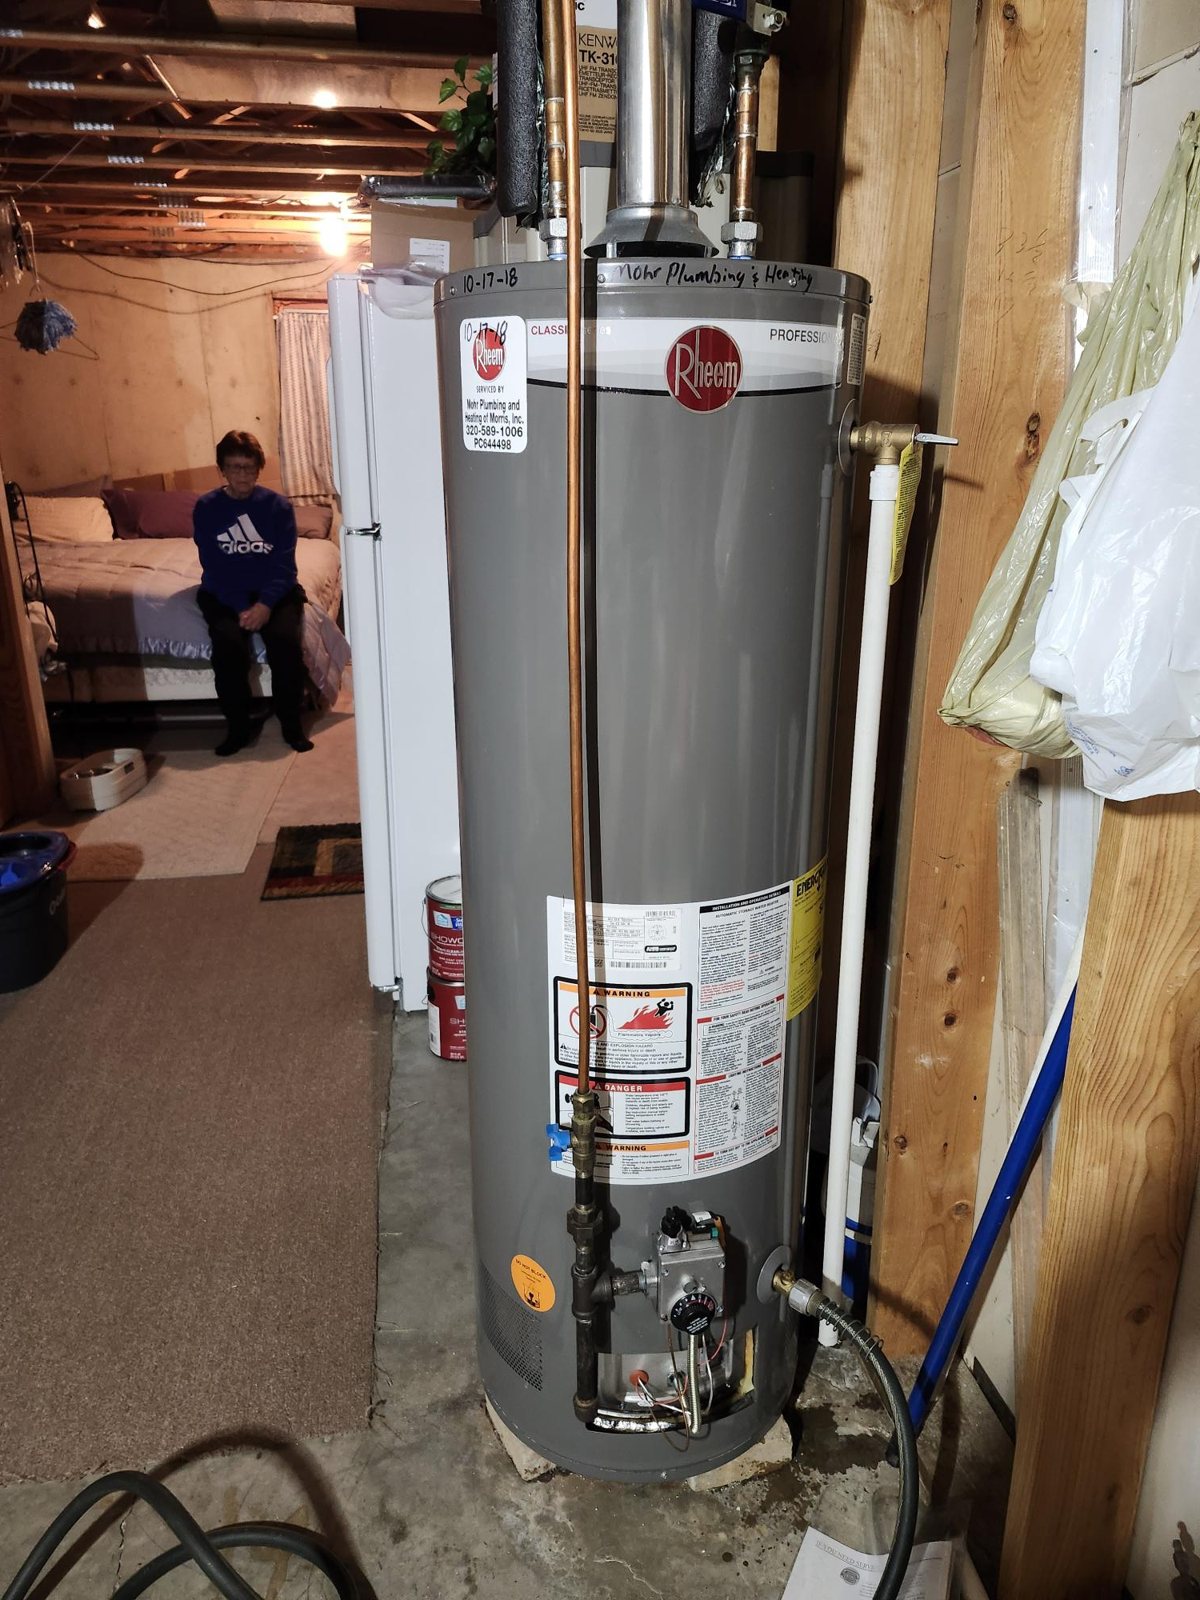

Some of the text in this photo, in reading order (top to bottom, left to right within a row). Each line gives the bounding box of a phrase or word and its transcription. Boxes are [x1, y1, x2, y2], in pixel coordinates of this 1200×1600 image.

[578, 33, 617, 48] KENW
[578, 49, 617, 65] TK-31
[463, 267, 519, 293] 10-17-18
[666, 262, 746, 288] Plumbing
[464, 320, 508, 346] 10-17-18
[530, 324, 568, 336] CLASSI
[475, 330, 503, 373] Rheem
[675, 329, 738, 400] Rheem
[476, 385, 505, 394] SERVICED BY
[480, 399, 507, 414] Plumbing
[508, 399, 520, 411] and
[512, 413, 525, 424] Inc.
[465, 425, 524, 438] 320-589-1006
[474, 438, 512, 450] PC644498
[222, 540, 274, 554] adidas
[605, 1083, 643, 1092] DANGER
[606, 1144, 647, 1152] WARNING
